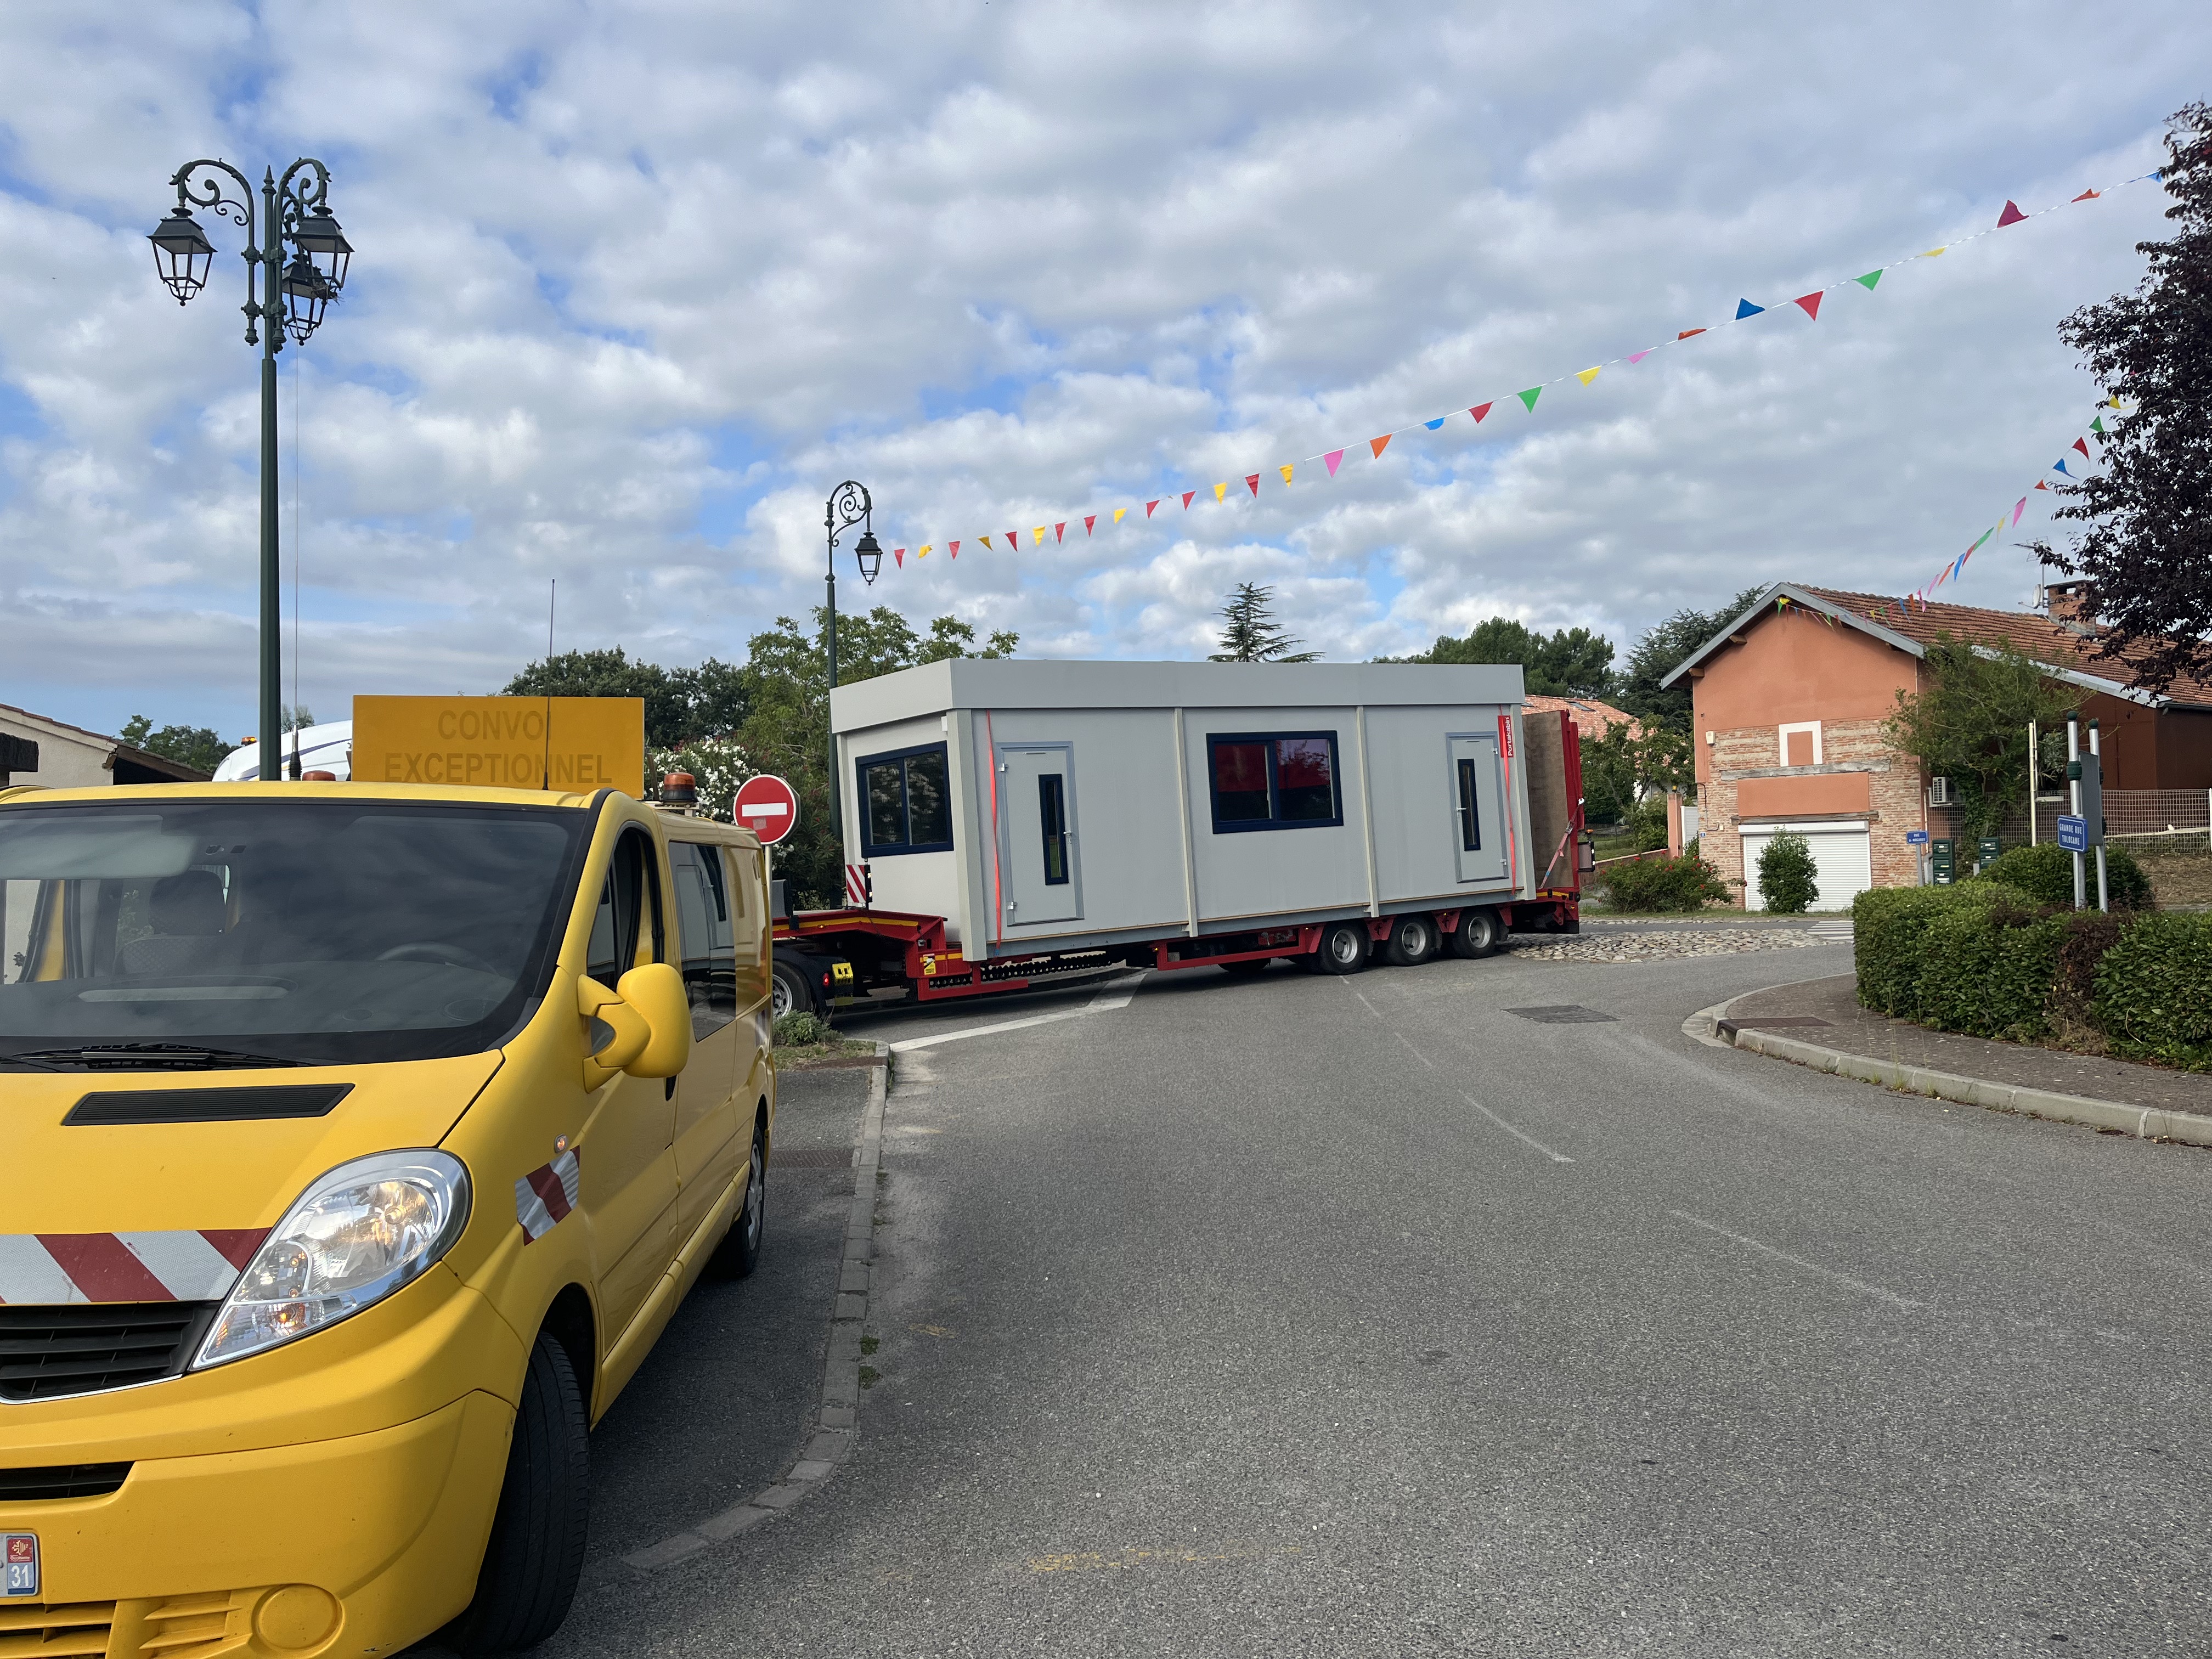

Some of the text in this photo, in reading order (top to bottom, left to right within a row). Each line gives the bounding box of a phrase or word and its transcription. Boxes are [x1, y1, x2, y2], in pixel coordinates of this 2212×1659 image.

[385, 753, 613, 783] EXCEPTIONNEL
[2059, 823, 2074, 833] GRANDE
[2062, 834, 2080, 845] TOLOSANE
[11, 1565, 29, 1587] 31
